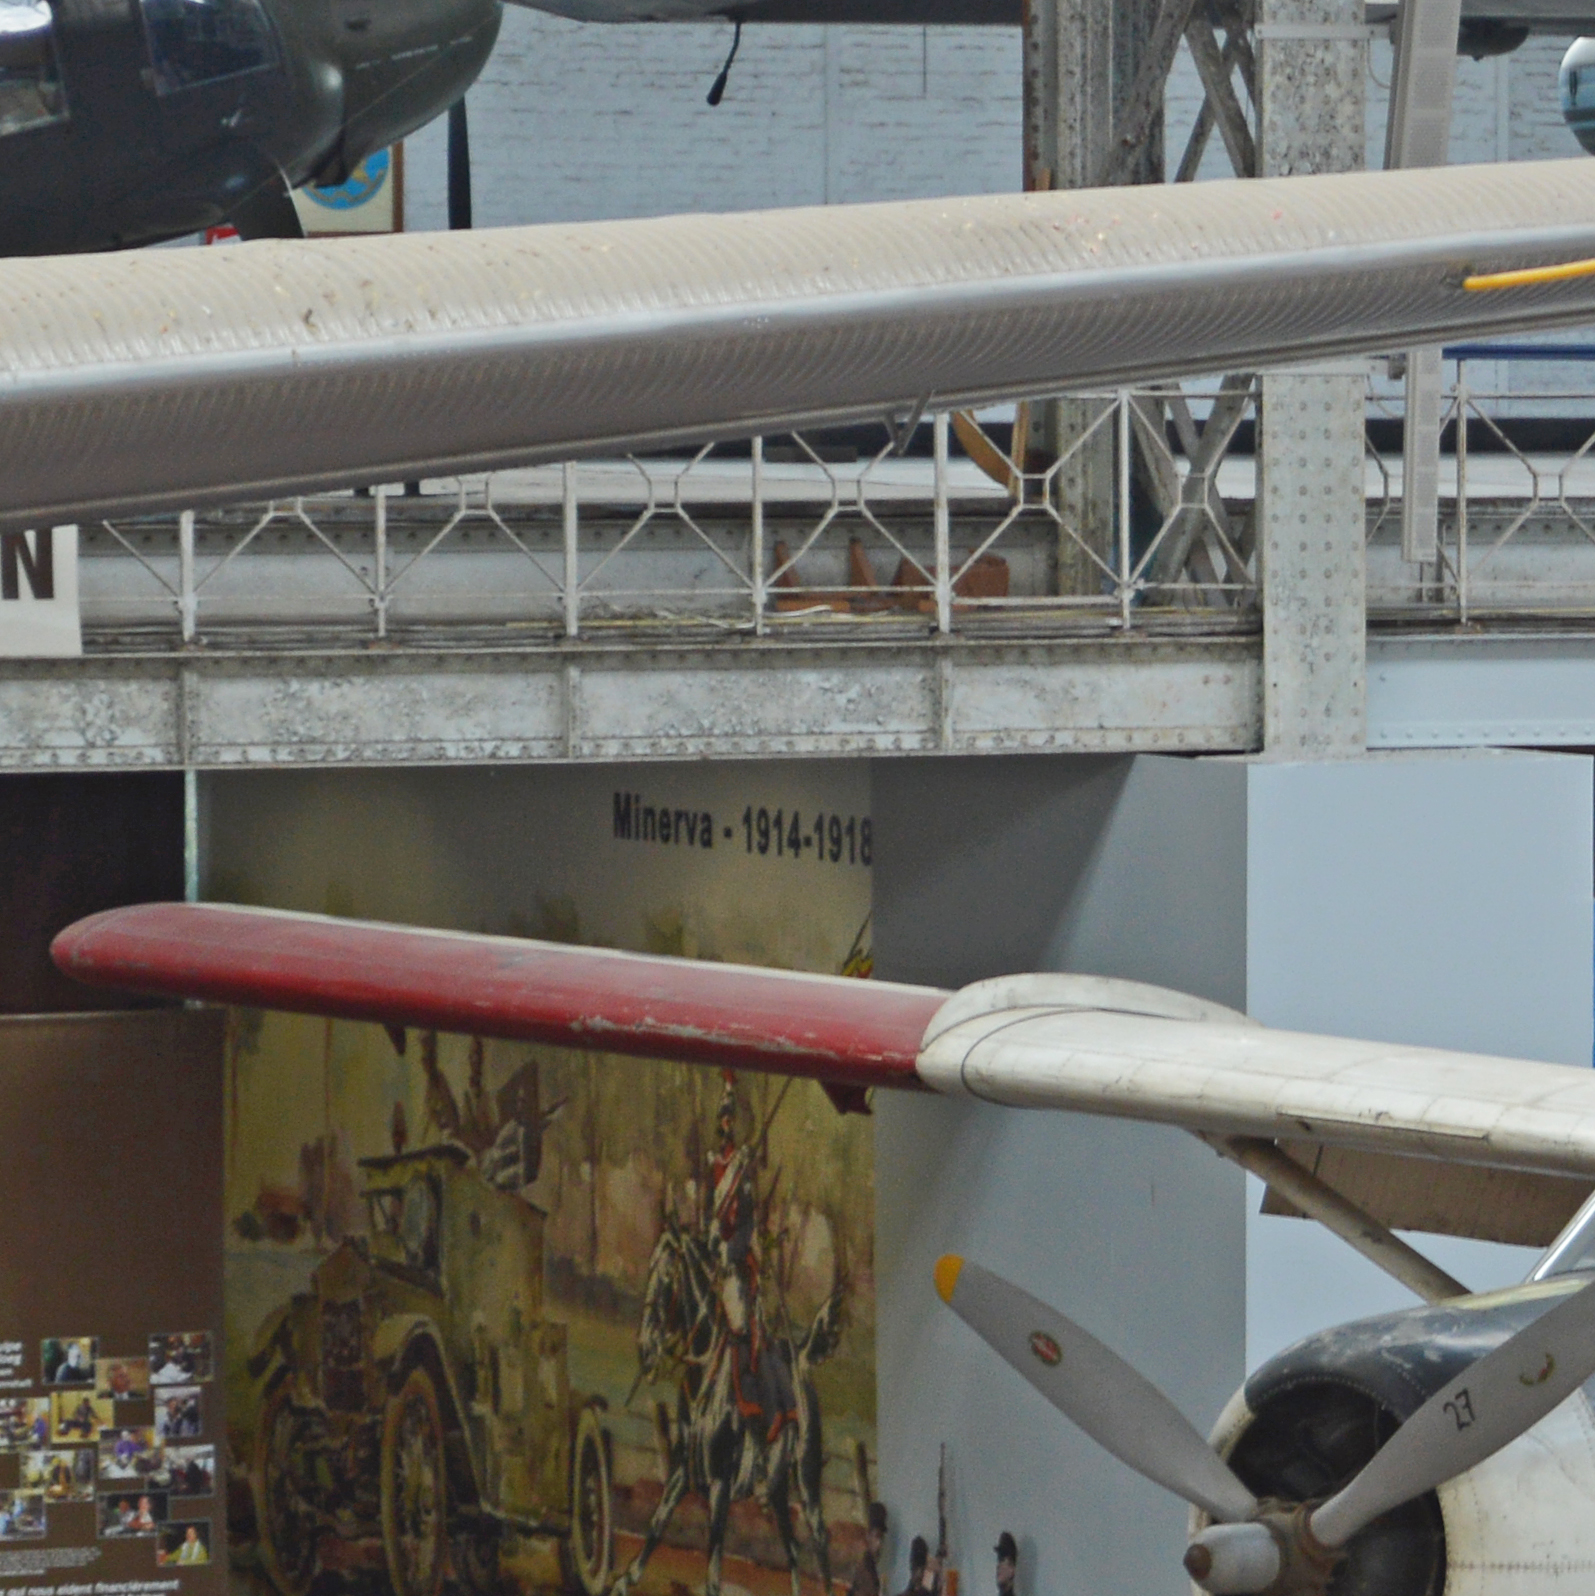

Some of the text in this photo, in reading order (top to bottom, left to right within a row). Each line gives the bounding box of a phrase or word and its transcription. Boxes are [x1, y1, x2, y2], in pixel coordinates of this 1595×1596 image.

[613, 792, 713, 848] Minerva
[742, 805, 873, 866] 1914-1918
[1443, 1387, 1476, 1431] 27
